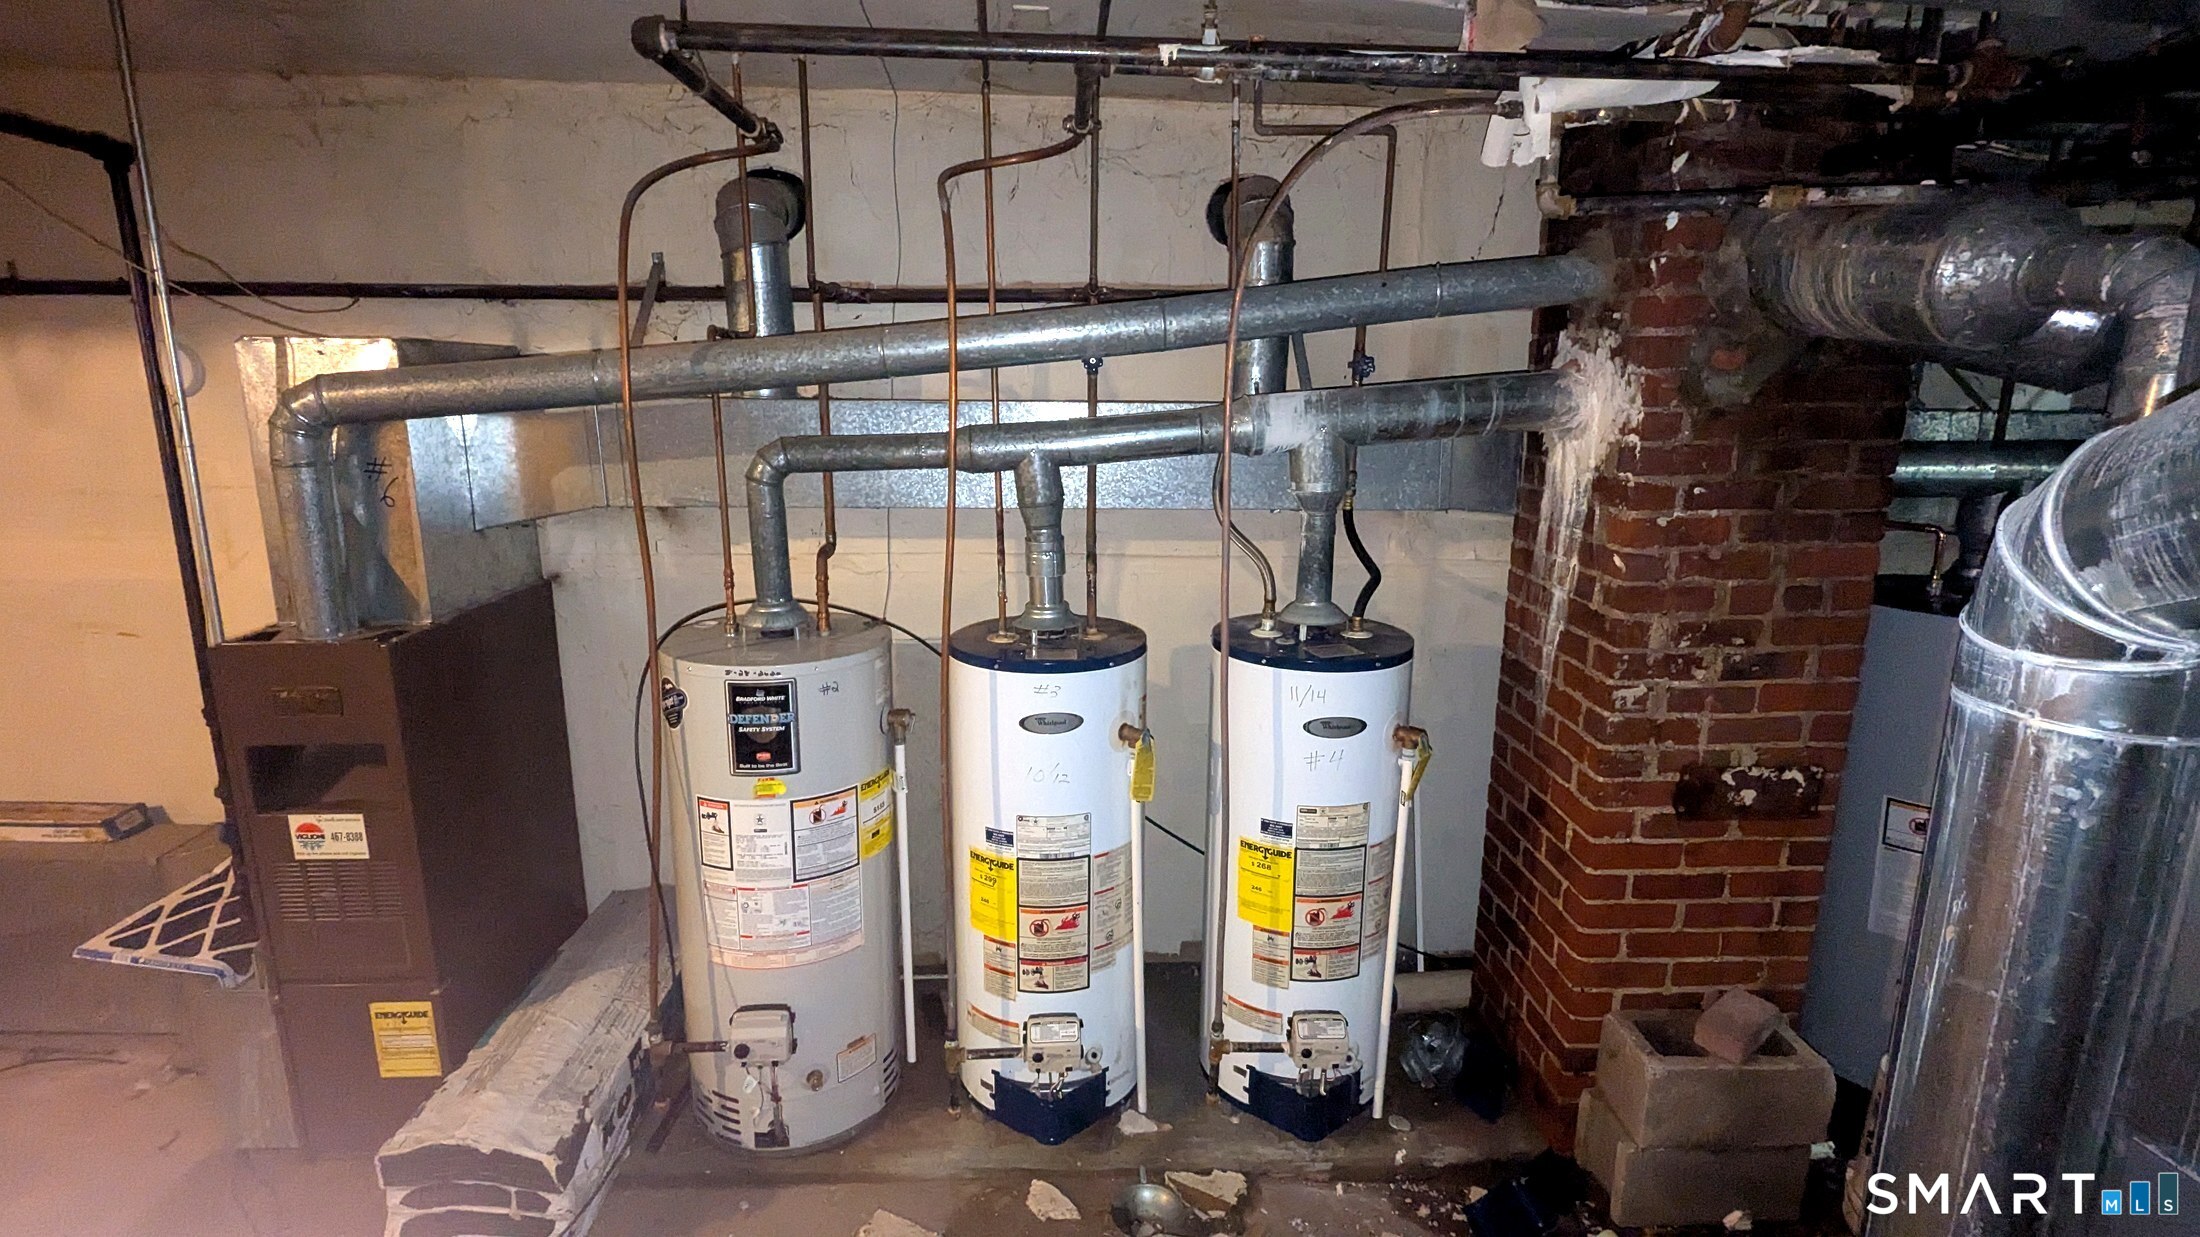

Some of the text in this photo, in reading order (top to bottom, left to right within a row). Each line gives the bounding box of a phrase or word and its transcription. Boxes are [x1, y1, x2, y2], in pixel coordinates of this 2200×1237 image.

[819, 681, 840, 696] #2
[1033, 684, 1062, 698] #3
[1290, 684, 1327, 708] 11/14
[729, 712, 796, 725] DEFENDER
[1035, 717, 1067, 726] Whirlpool
[1026, 763, 1071, 784] 10/12
[1240, 839, 1293, 859] ENERGYGUIDE
